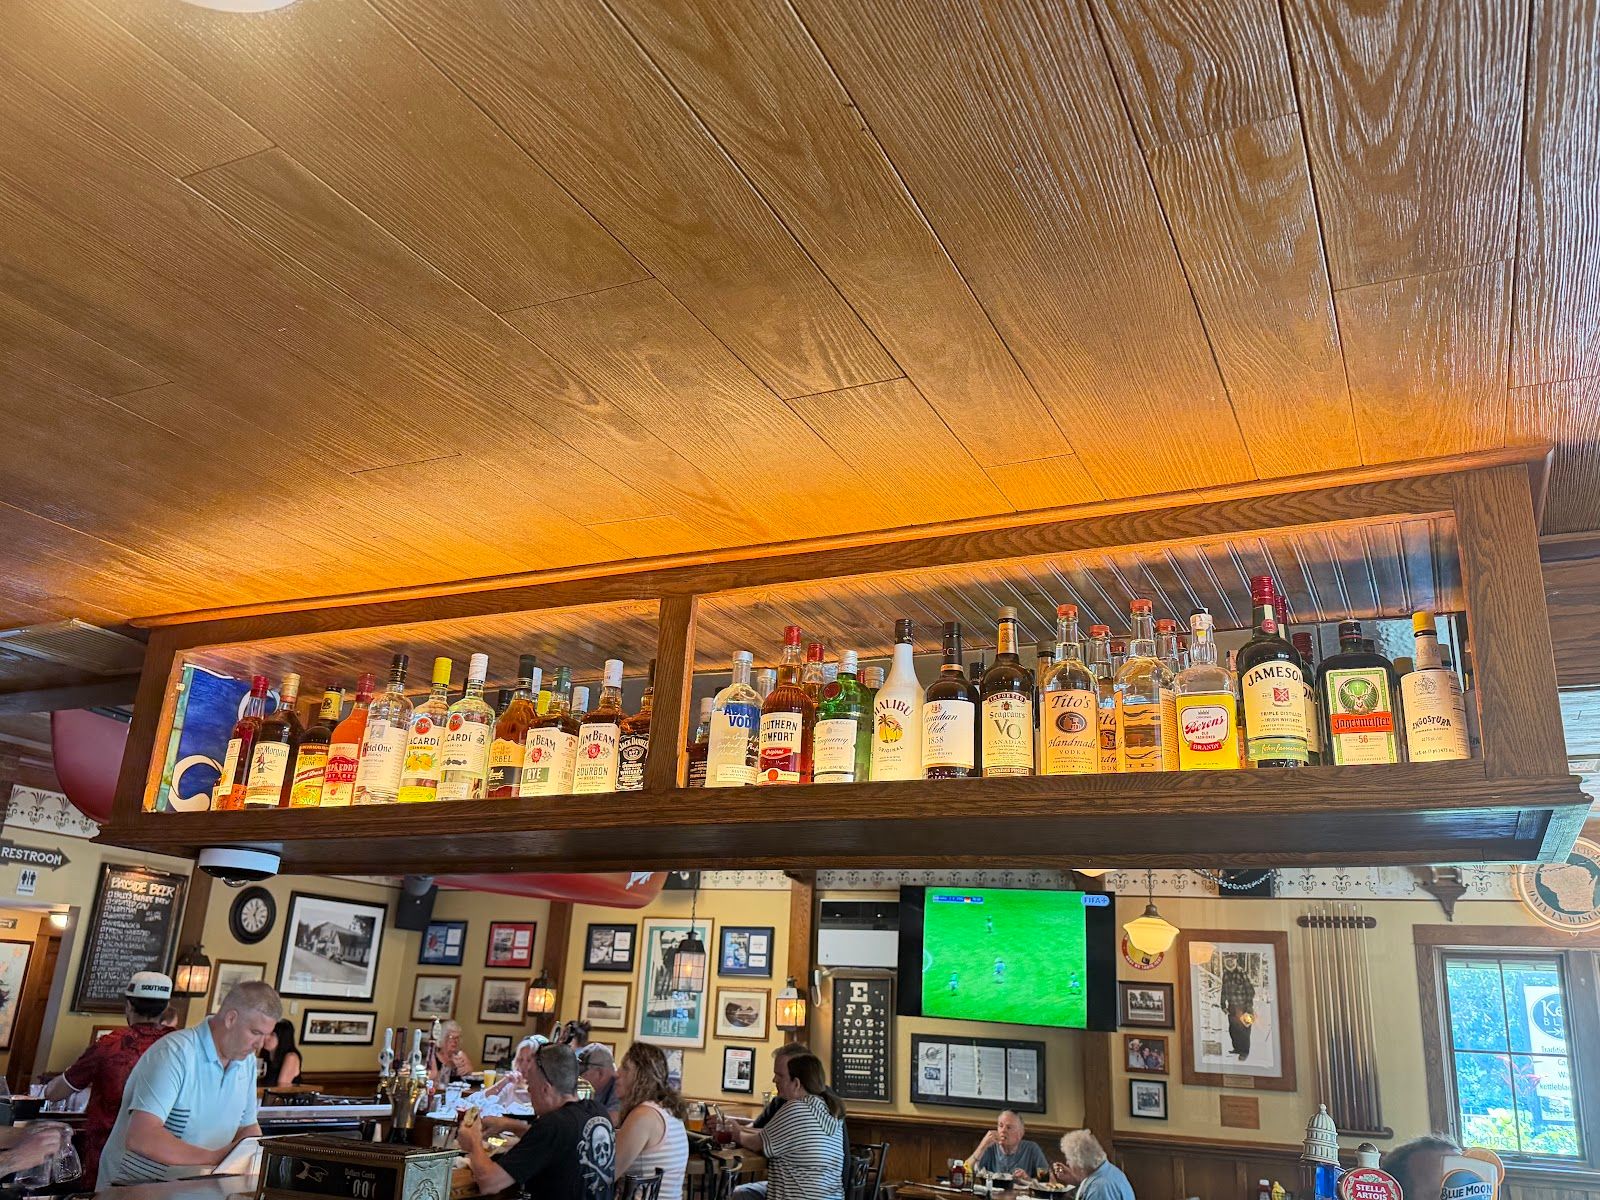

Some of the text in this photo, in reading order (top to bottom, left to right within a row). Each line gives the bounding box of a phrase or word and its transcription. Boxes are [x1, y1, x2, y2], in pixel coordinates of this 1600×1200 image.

[989, 692, 1026, 703] IMPORTED
[1051, 693, 1091, 709] Tito's
[875, 699, 914, 717] MALIBU
[729, 716, 752, 728] VOD
[760, 719, 798, 733] SOUTHERN
[1412, 715, 1452, 730] ANGOSTURA
[994, 719, 1022, 740] VO
[446, 732, 472, 742] CARDÍ
[536, 734, 556, 752] BEAM
[579, 730, 615, 749] JIM BEAM
[761, 731, 795, 743] COMFORT
[1048, 736, 1096, 748] Handmade
[1358, 734, 1368, 744] 56
[264, 745, 288, 758] Morgan
[378, 743, 393, 753] One
[1192, 743, 1220, 751] BRANDY
[492, 754, 513, 763] ORBEL
[526, 767, 542, 780] RYE
[577, 766, 609, 776] BOURBON
[1, 847, 63, 866] RESTROOM
[149, 883, 176, 898] BEER
[850, 982, 868, 1002] E
[1541, 1000, 1564, 1017] Ke
[1543, 1017, 1560, 1027] BL
[1541, 1045, 1567, 1054] Traditio
[1539, 1082, 1571, 1091] kettlebla
[1355, 1183, 1386, 1194] STELLA
[1441, 1183, 1494, 1200] BLUE MOON
[1351, 1191, 1389, 1200] ARTOIS
